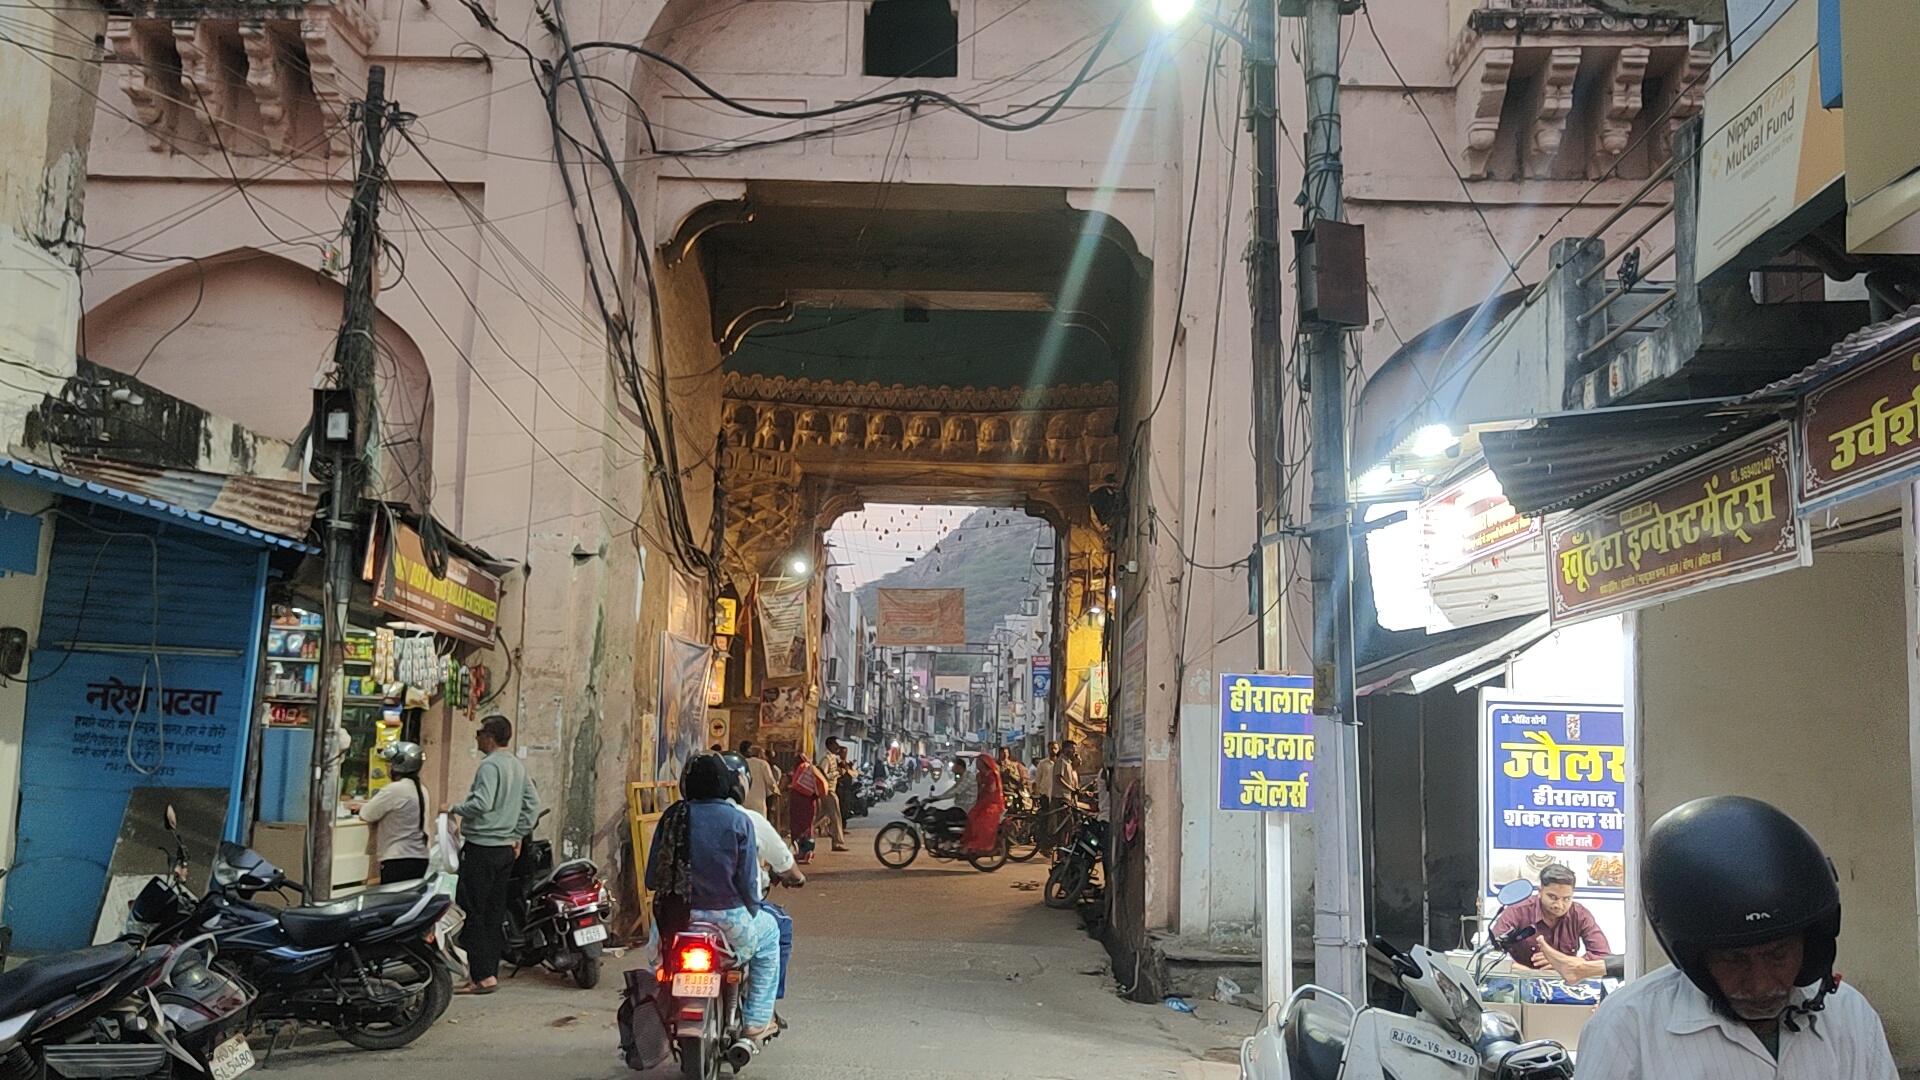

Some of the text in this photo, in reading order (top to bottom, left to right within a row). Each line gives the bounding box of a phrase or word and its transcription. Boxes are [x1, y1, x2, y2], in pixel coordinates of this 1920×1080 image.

[1725, 96, 1796, 176] Mutual Fund
[1726, 104, 1763, 149] Nippon
[86, 676, 223, 716] नरेश पटवा
[1229, 677, 1314, 714] हीरालाल
[1531, 714, 1547, 725] सोनी
[1239, 770, 1309, 808] ज्वैलर्स
[1532, 784, 1617, 808] हीरालाल
[1503, 805, 1597, 829] शंकरलाल
[1450, 1049, 1475, 1066] 3120
